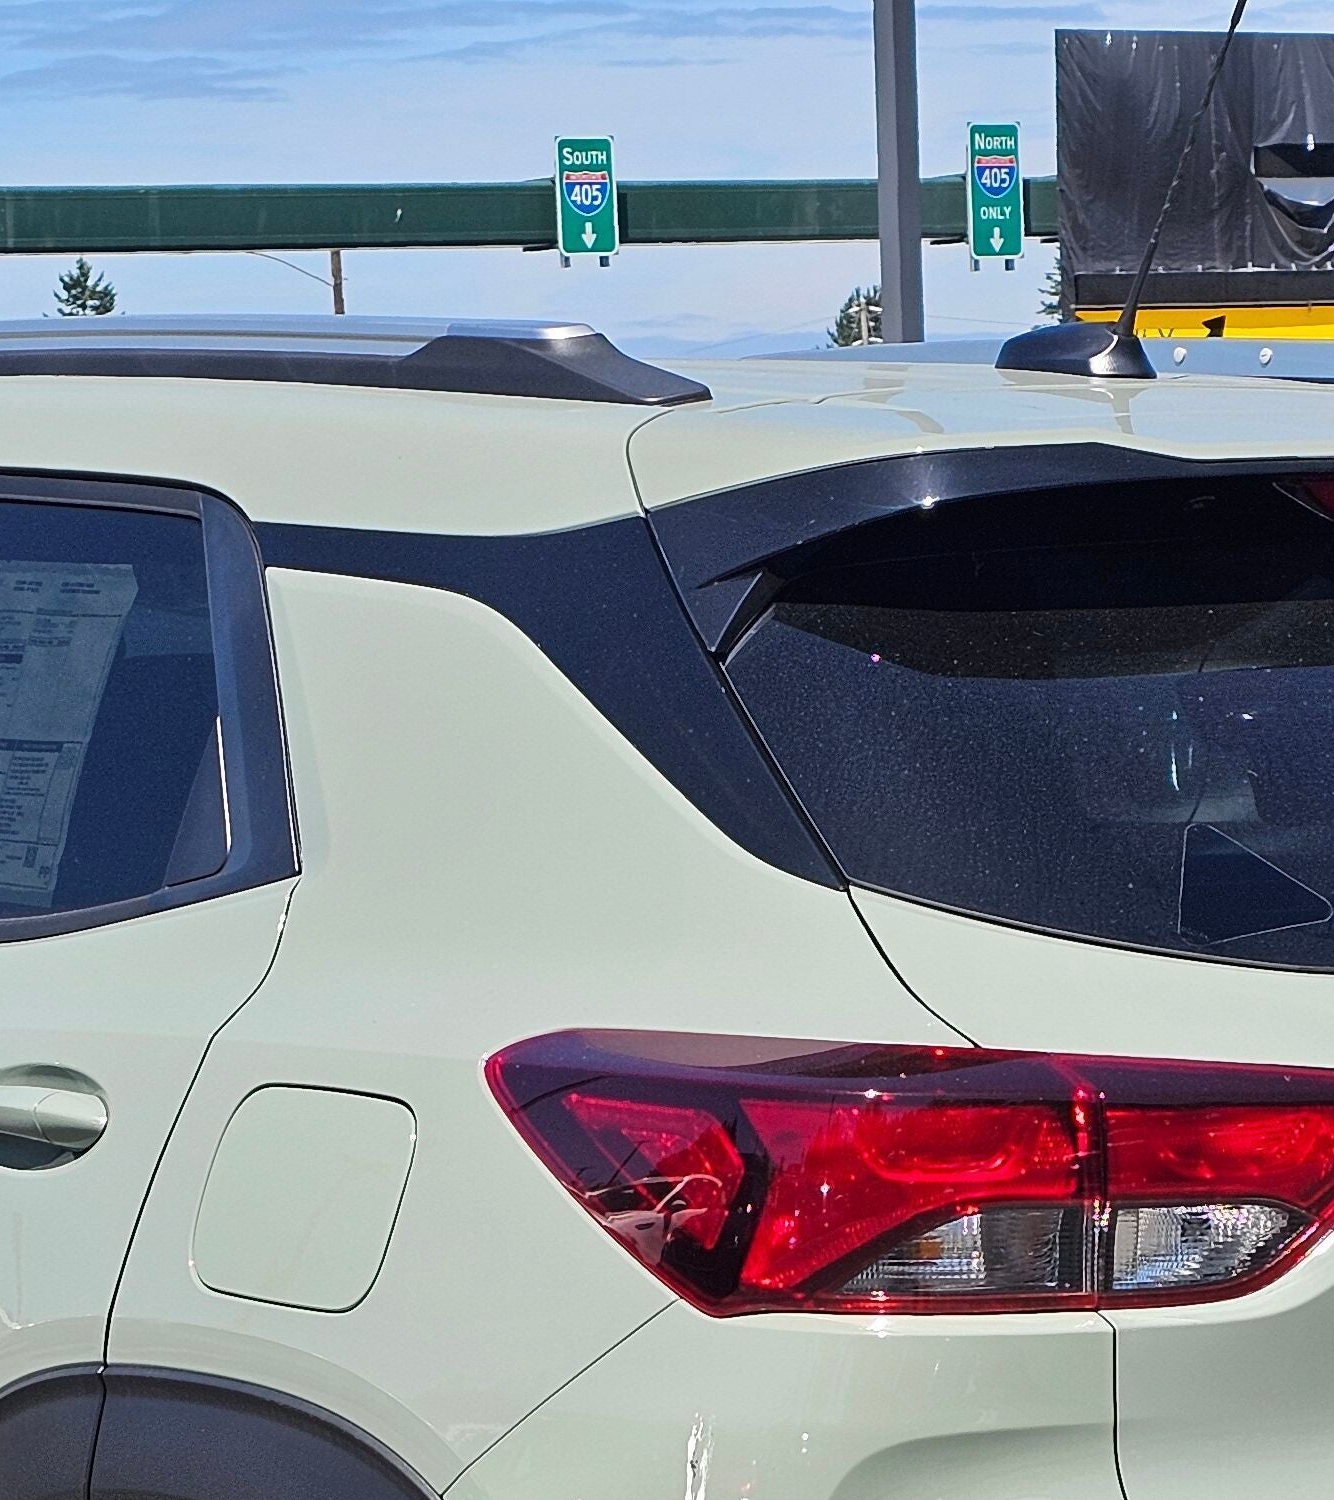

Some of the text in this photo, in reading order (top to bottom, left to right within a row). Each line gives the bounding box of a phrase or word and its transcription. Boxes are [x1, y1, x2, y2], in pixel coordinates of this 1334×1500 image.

[974, 132, 1015, 150] NORTH
[562, 147, 607, 165] SOUTH
[980, 167, 1010, 188] 405
[570, 184, 603, 206] 405
[980, 206, 1012, 220] ONLY
